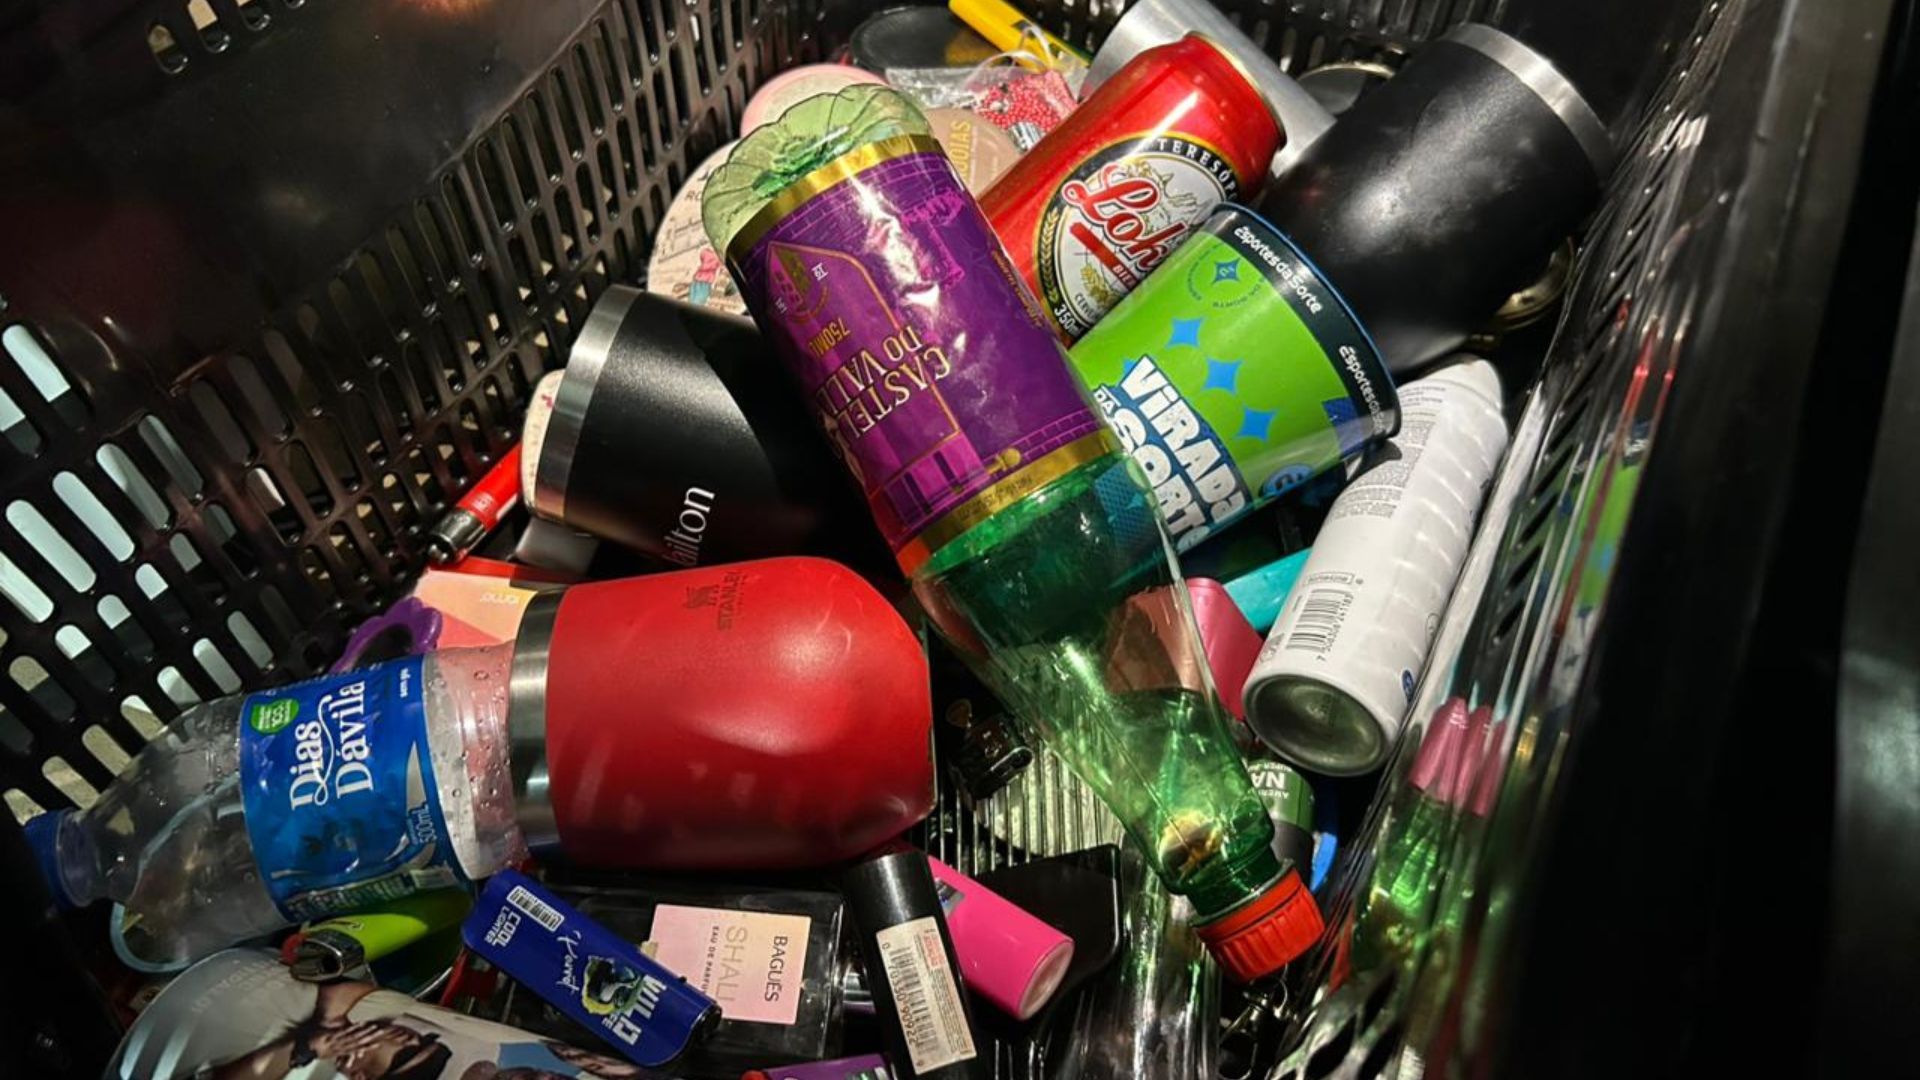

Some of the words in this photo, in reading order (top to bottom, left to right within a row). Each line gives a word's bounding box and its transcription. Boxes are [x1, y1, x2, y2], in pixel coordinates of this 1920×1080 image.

[883, 326, 923, 362] DO
[288, 719, 325, 811] Dias
[328, 680, 374, 799] Dávila
[492, 910, 521, 947] COOL
